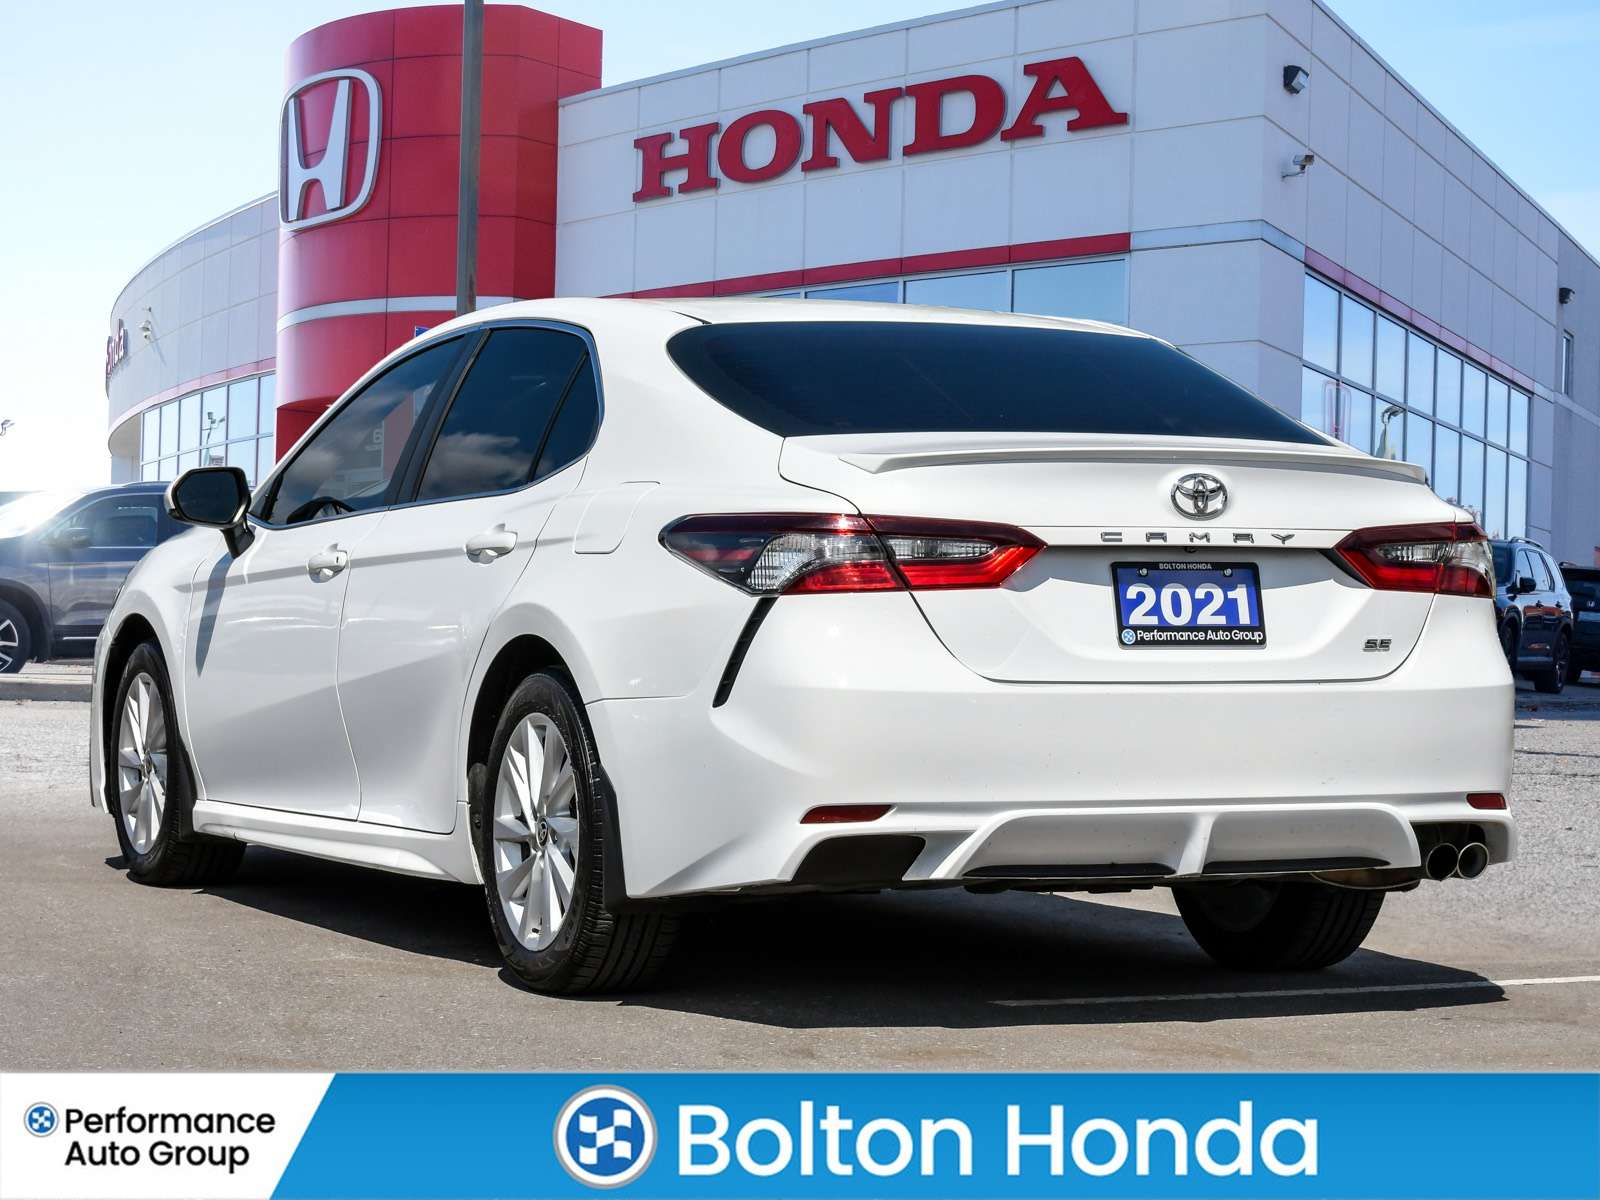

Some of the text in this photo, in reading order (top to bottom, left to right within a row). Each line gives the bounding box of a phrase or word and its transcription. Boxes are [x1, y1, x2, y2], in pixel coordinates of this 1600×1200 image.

[632, 56, 1129, 203] HONDA
[1100, 531, 1296, 545] CAMRY
[1159, 562, 1213, 570] BOLTON HONDA
[1126, 582, 1251, 626] 2021
[1136, 629, 1264, 644] Performance Auto Group
[1364, 638, 1392, 650] SE
